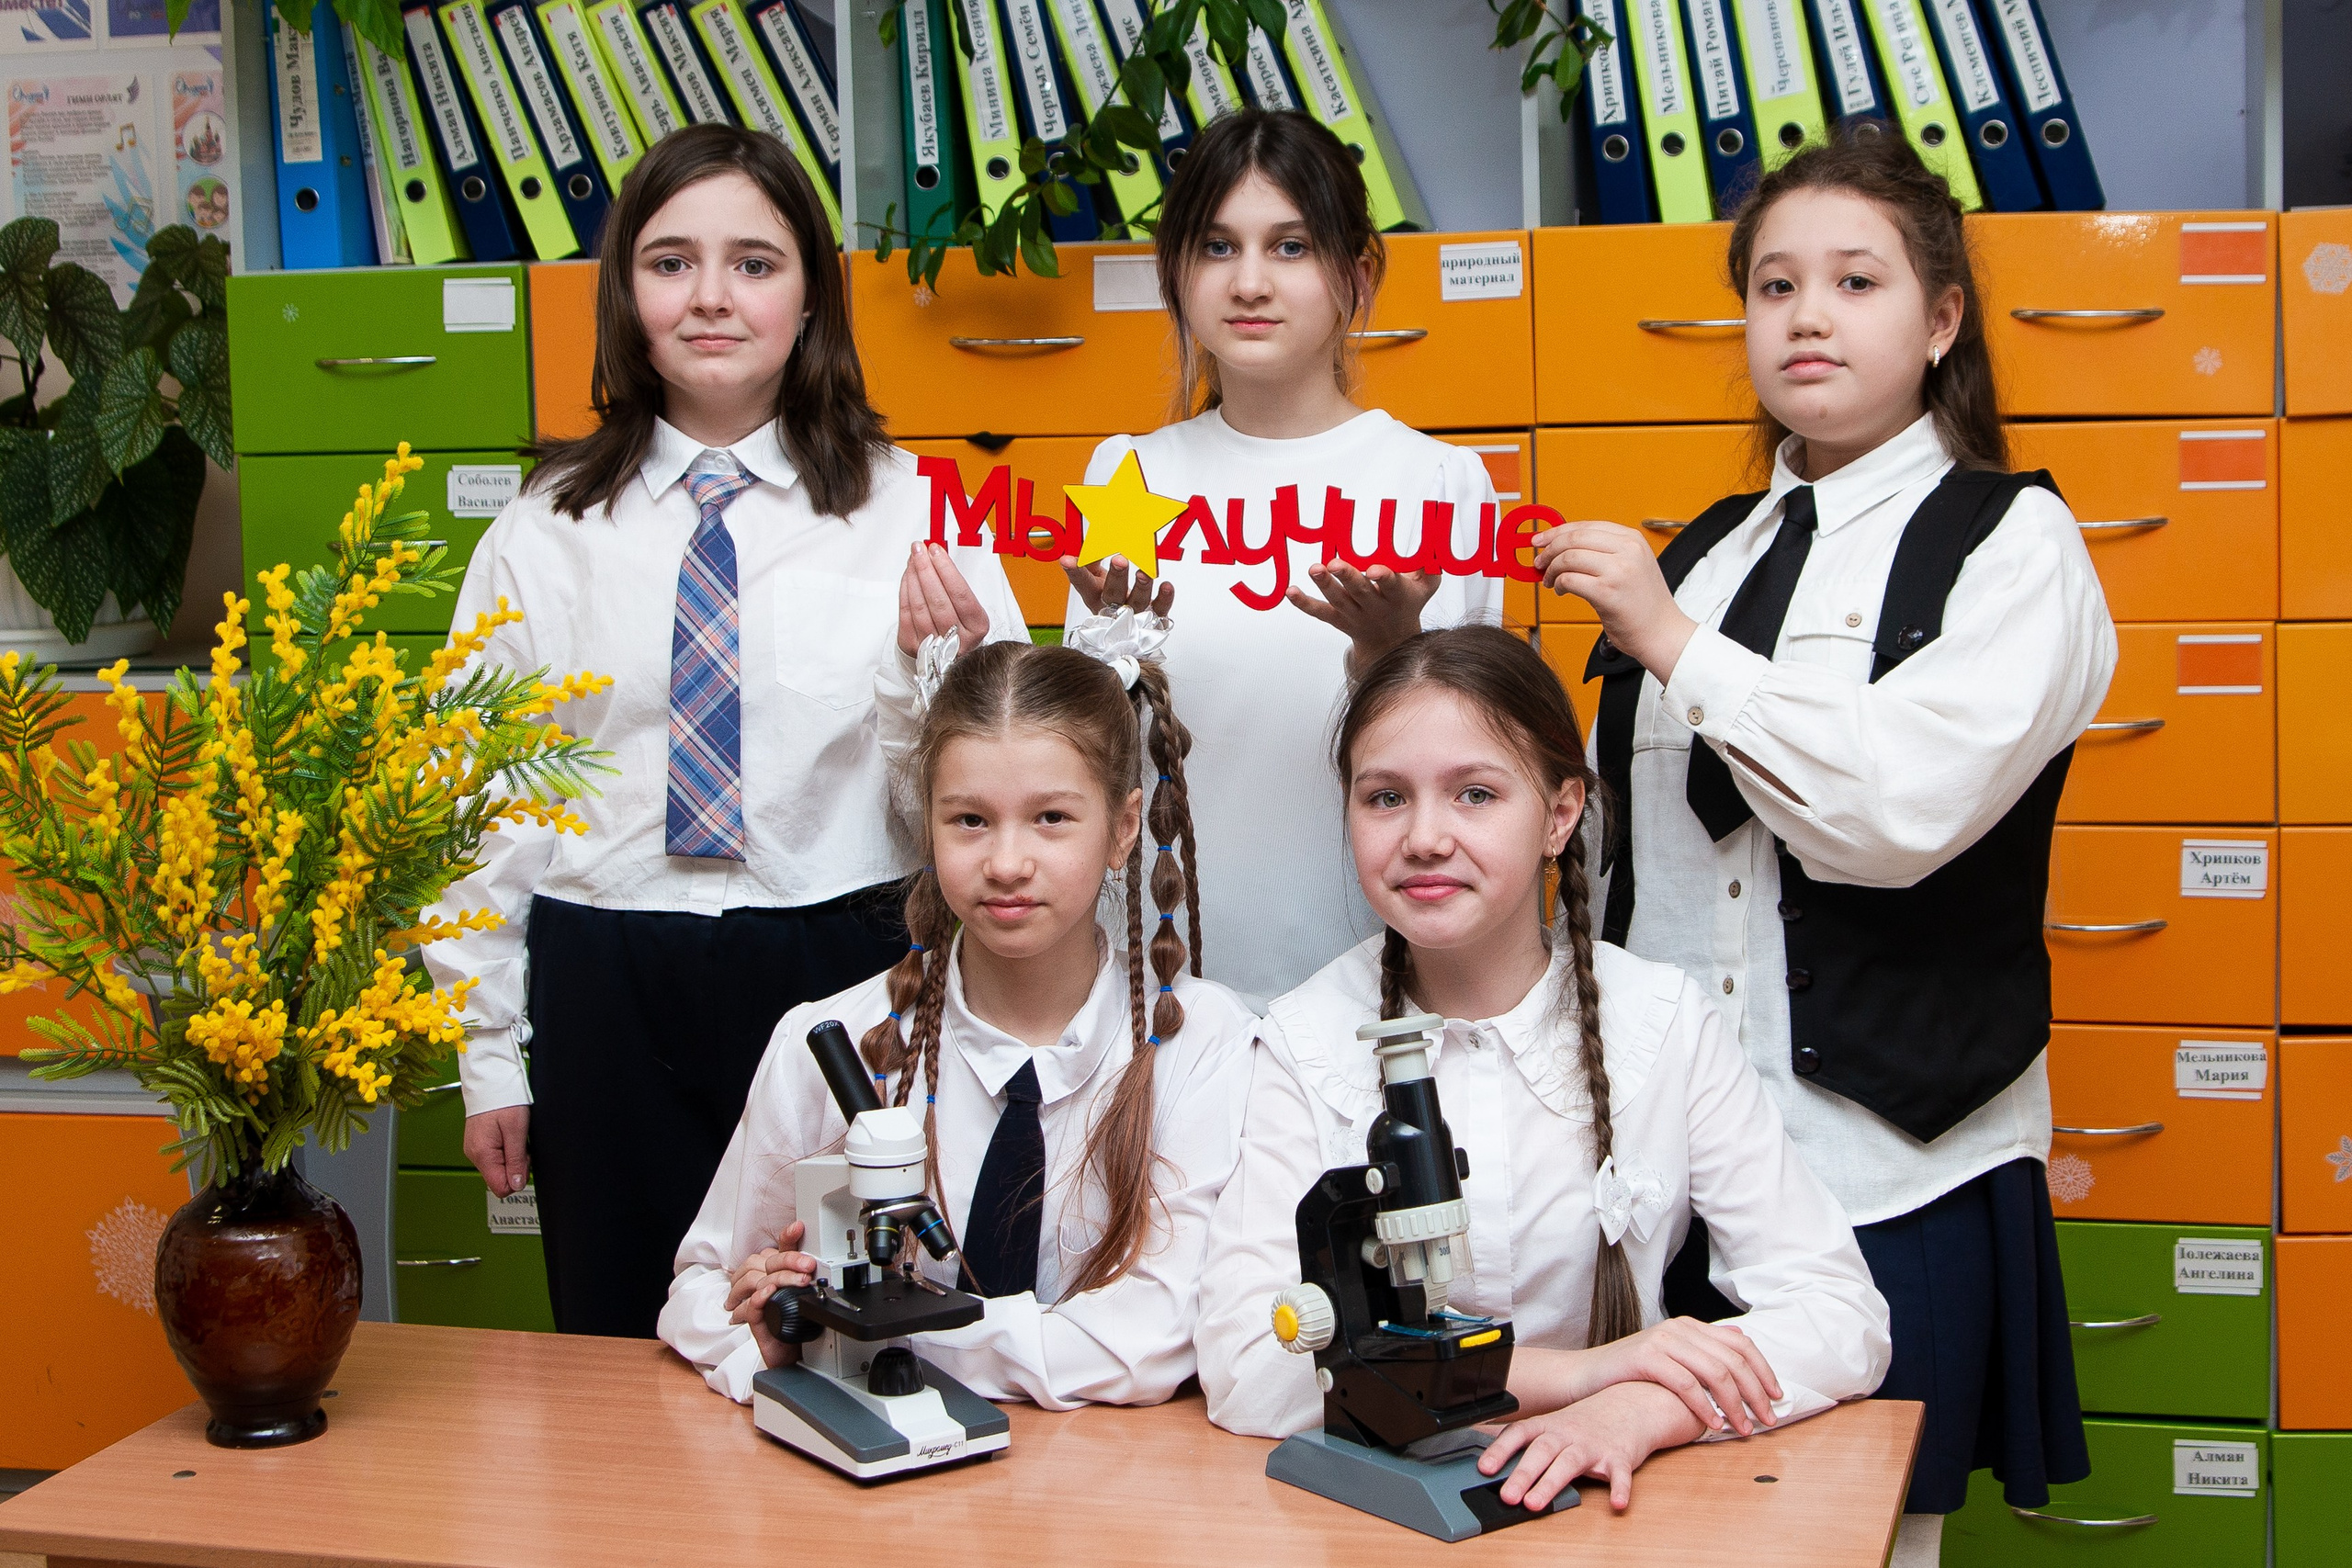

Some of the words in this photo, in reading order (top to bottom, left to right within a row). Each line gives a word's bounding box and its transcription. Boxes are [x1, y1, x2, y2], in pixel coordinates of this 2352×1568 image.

[461, 4, 495, 75] Анастасия
[503, 8, 538, 67] Андрей
[568, 31, 591, 73] Катя
[610, 15, 654, 96] Анастасия
[656, 7, 688, 72] Максим
[709, 8, 744, 64] Мария
[768, 7, 815, 92] Александр
[914, 10, 931, 80] Кирилл
[969, 0, 989, 63] Ксения
[1020, 5, 1041, 60] Семён
[1767, 0, 1792, 92] Черепанов
[376, 50, 391, 76] Ва
[423, 41, 450, 107] Никита
[1301, 25, 1348, 116] Касаткина
[1709, 57, 1732, 116] Питай
[1839, 45, 1863, 96] Гуляй
[289, 74, 307, 128] Чудов
[385, 78, 416, 168] Нагорнова
[490, 80, 526, 161] Панченко
[533, 71, 575, 156] Арзамасов
[586, 73, 629, 160] Ковтунова
[920, 85, 938, 157] Якубаев
[982, 66, 1006, 139] Минина
[1035, 64, 1059, 133] Черных
[444, 107, 470, 162] Алман
[1442, 253, 1520, 270] природный
[1450, 274, 1514, 287] материал
[458, 473, 511, 486] Соболев
[917, 455, 1085, 562] Мы
[1156, 483, 1567, 611] лучшие
[2189, 851, 2261, 866] Хрипков
[2200, 872, 2250, 886] Артём
[2177, 1052, 2267, 1063] Мельникова
[2195, 1069, 2248, 1084] Мария
[2178, 1266, 2254, 1280] Ангелина
[2188, 1472, 2247, 1484] Никита
[2192, 1450, 2245, 1461] Алман
